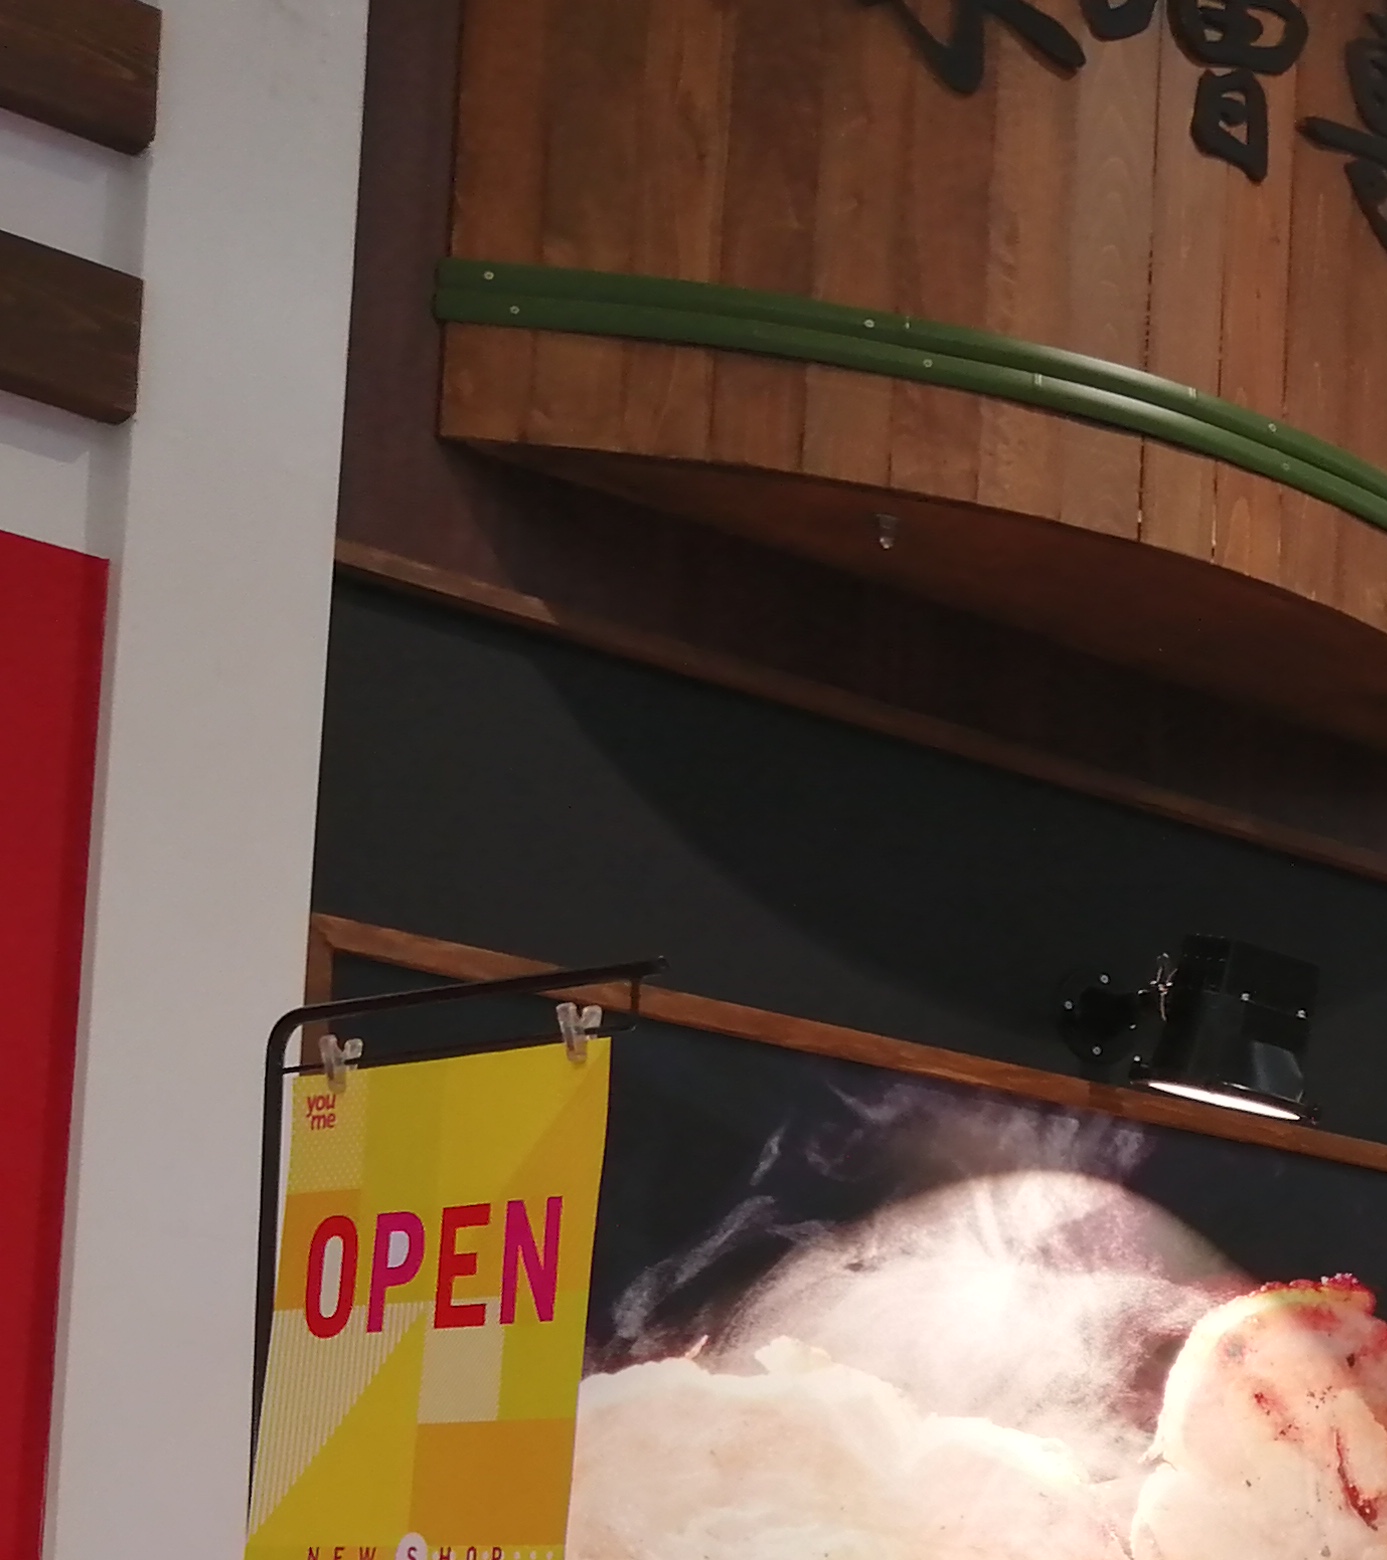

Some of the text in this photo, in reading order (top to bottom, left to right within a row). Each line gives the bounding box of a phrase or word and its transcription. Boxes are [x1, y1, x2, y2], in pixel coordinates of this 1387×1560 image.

[306, 1094, 336, 1117] you
[310, 1113, 336, 1130] me
[305, 1196, 563, 1339] OPEN
